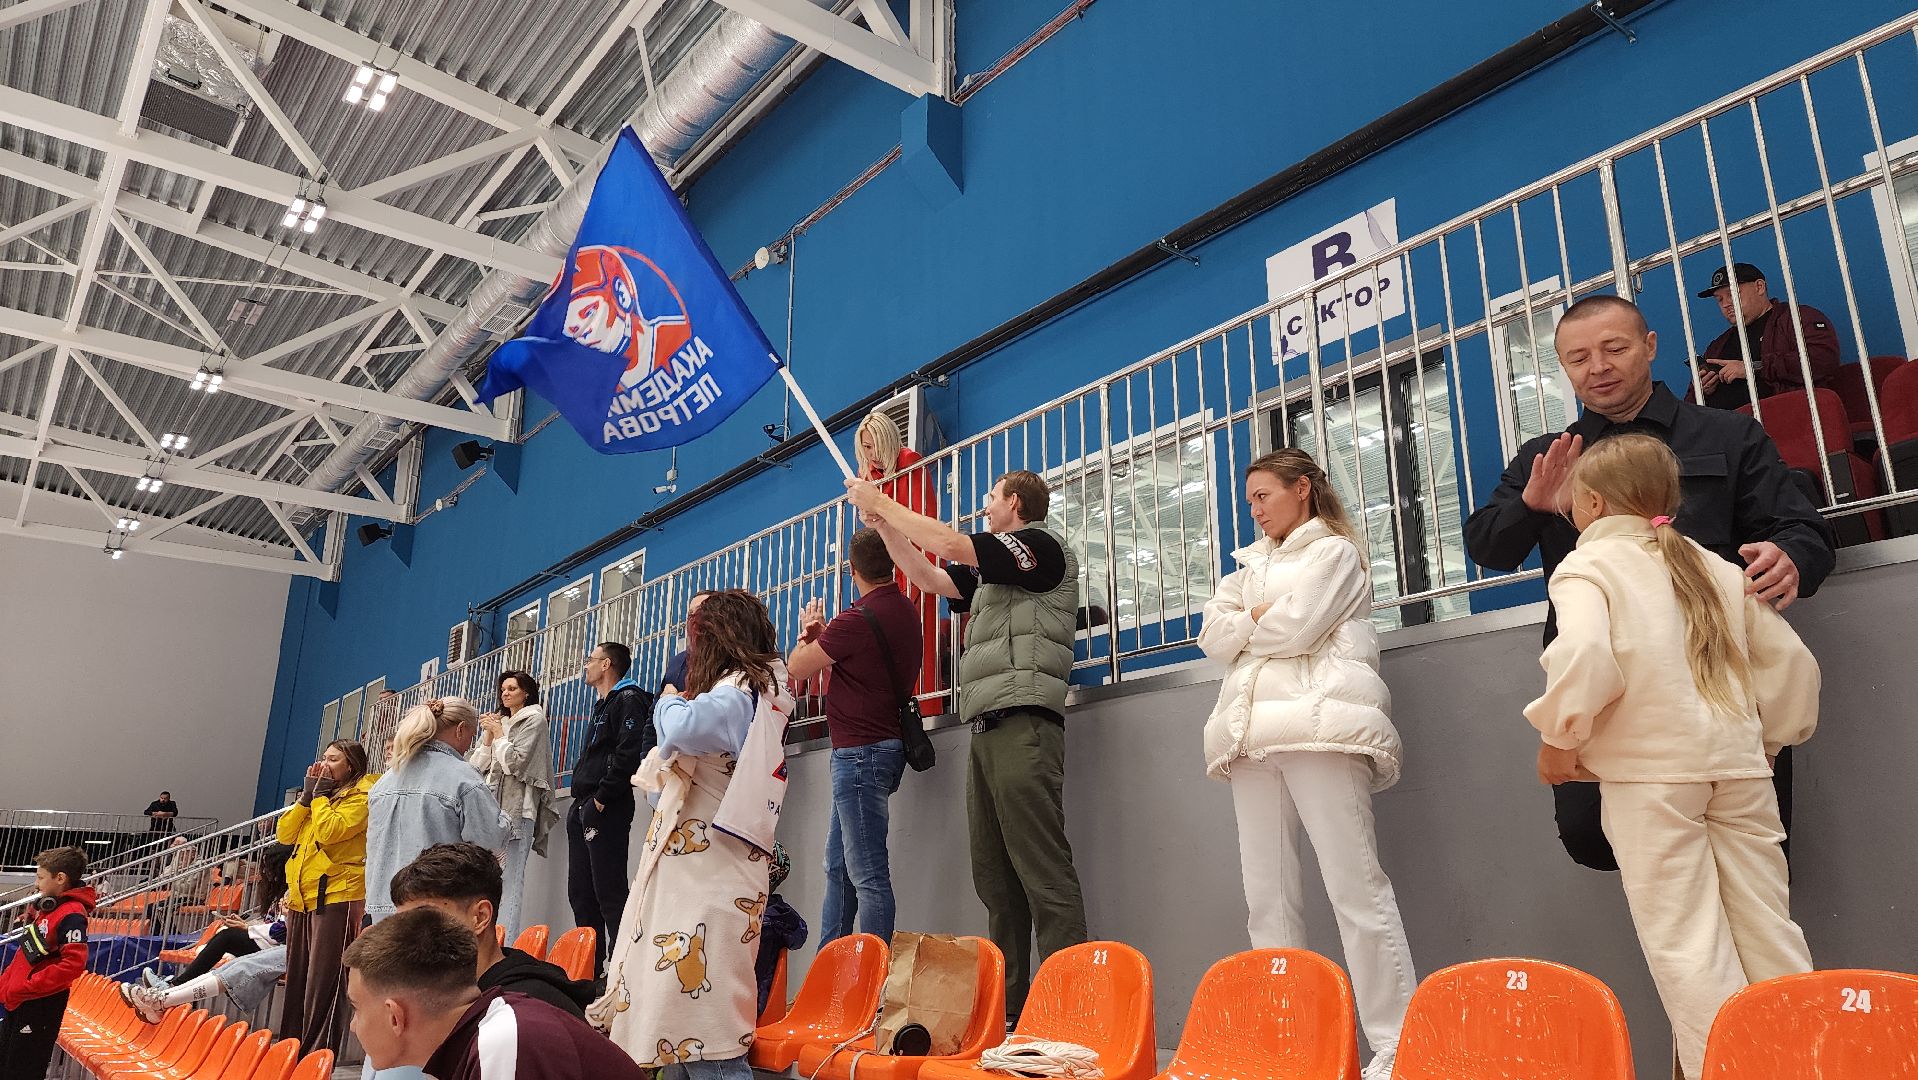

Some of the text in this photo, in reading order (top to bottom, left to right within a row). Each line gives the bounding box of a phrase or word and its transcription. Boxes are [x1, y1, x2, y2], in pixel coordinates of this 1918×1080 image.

[65, 929, 82, 943] 19
[1093, 949, 1108, 965] 21
[1270, 957, 1287, 975] 22
[1506, 969, 1528, 991] 23
[1841, 987, 1872, 1014] 24
